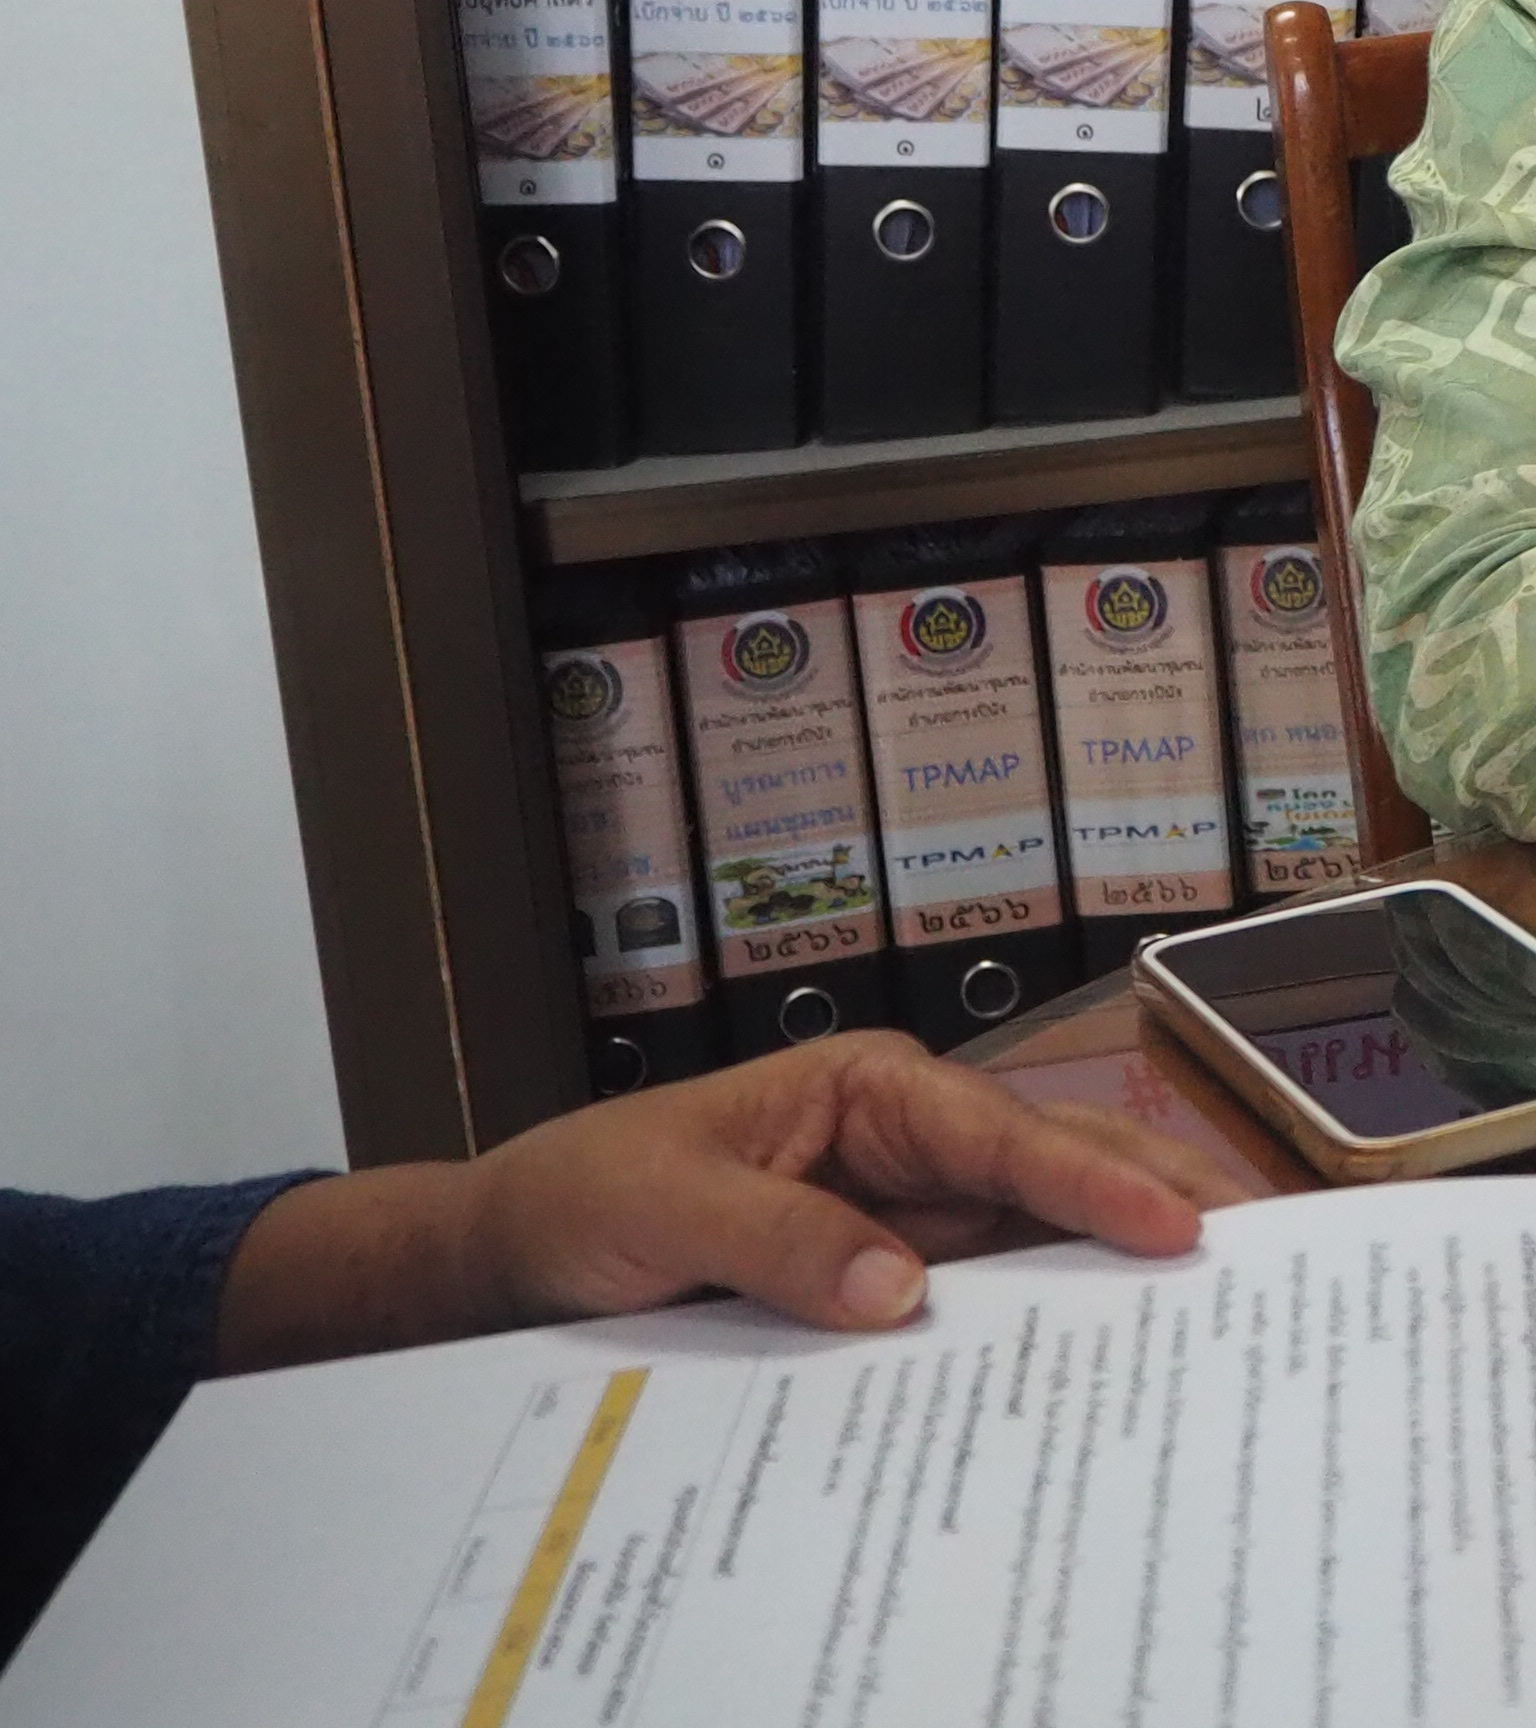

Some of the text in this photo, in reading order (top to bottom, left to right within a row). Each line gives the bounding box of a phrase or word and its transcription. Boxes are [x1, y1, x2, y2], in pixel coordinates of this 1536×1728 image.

[1081, 734, 1196, 766] TPMAP
[902, 753, 1021, 793] TPMAP
[1072, 820, 1220, 843] TPMAP
[896, 837, 1044, 871] TPMAP
[1103, 876, 1200, 907] ๒๕๖๖
[917, 897, 1031, 935] ๒๕๖๖
[744, 924, 860, 963] ๒๕๖๖
